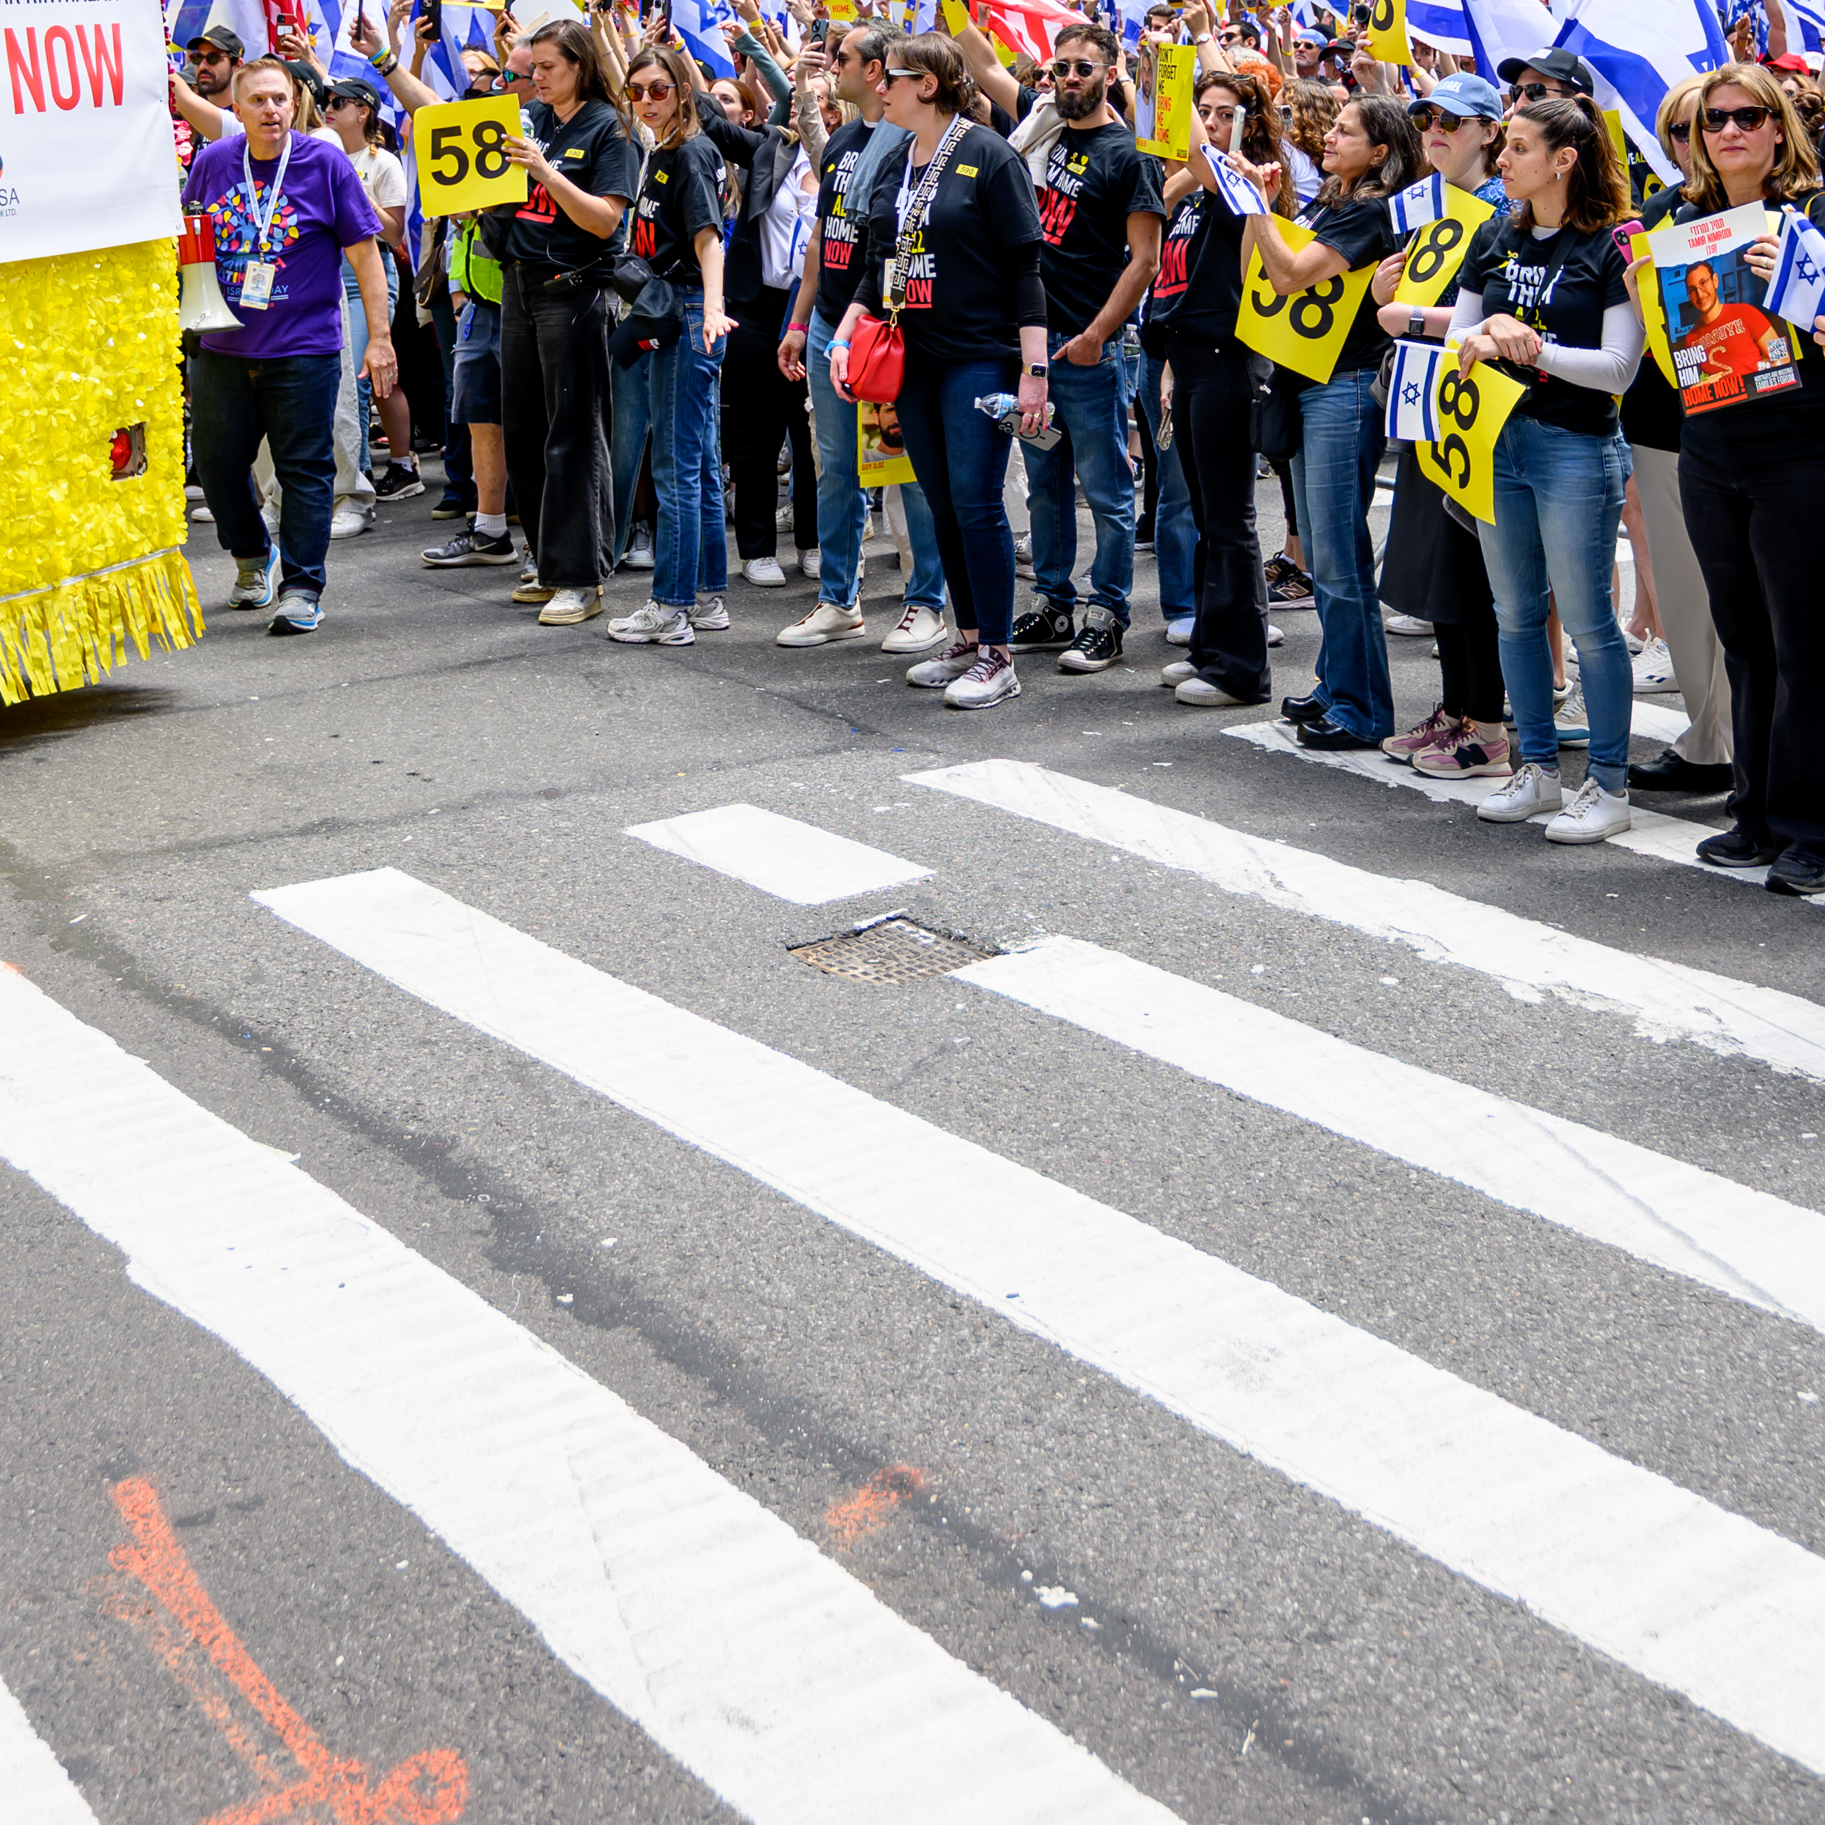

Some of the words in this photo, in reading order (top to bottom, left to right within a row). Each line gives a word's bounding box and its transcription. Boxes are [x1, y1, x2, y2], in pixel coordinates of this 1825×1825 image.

[5, 22, 128, 115] NOW
[430, 120, 512, 186] 58
[960, 166, 974, 176] 590
[4, 210, 17, 220] LTD.
[824, 216, 858, 244] HOME
[1687, 236, 1707, 249] TAMIR
[1707, 228, 1732, 245] NIMRODI
[824, 239, 853, 264] NOW
[1706, 243, 1718, 256] (19)
[1251, 264, 1344, 339] 58
[1673, 344, 1707, 369] BRING
[1678, 367, 1700, 388] HIM
[1682, 381, 1714, 407] HOME
[1713, 375, 1747, 398] NOW!
[1431, 369, 1481, 489] 58
